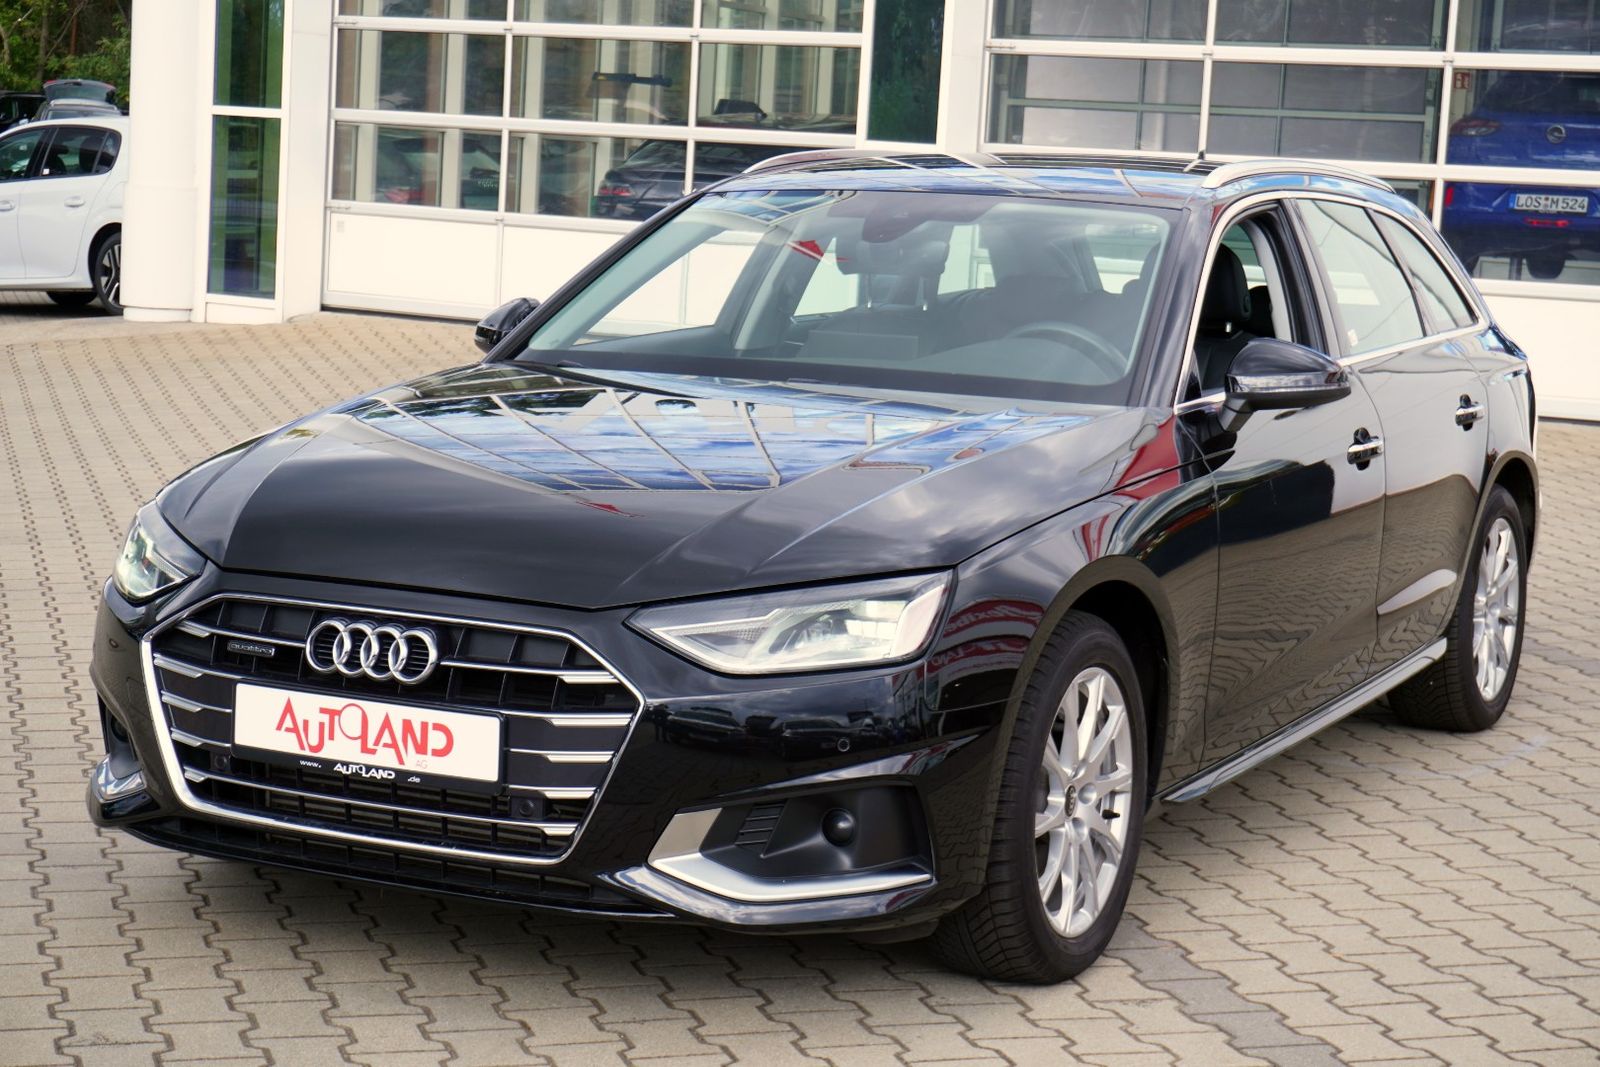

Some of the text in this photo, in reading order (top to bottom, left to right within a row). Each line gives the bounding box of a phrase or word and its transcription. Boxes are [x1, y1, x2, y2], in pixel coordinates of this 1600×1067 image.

[1516, 195, 1542, 208] LOS
[1561, 198, 1586, 210] 524
[275, 696, 454, 766] AUTOLAND
[415, 759, 428, 769] AG
